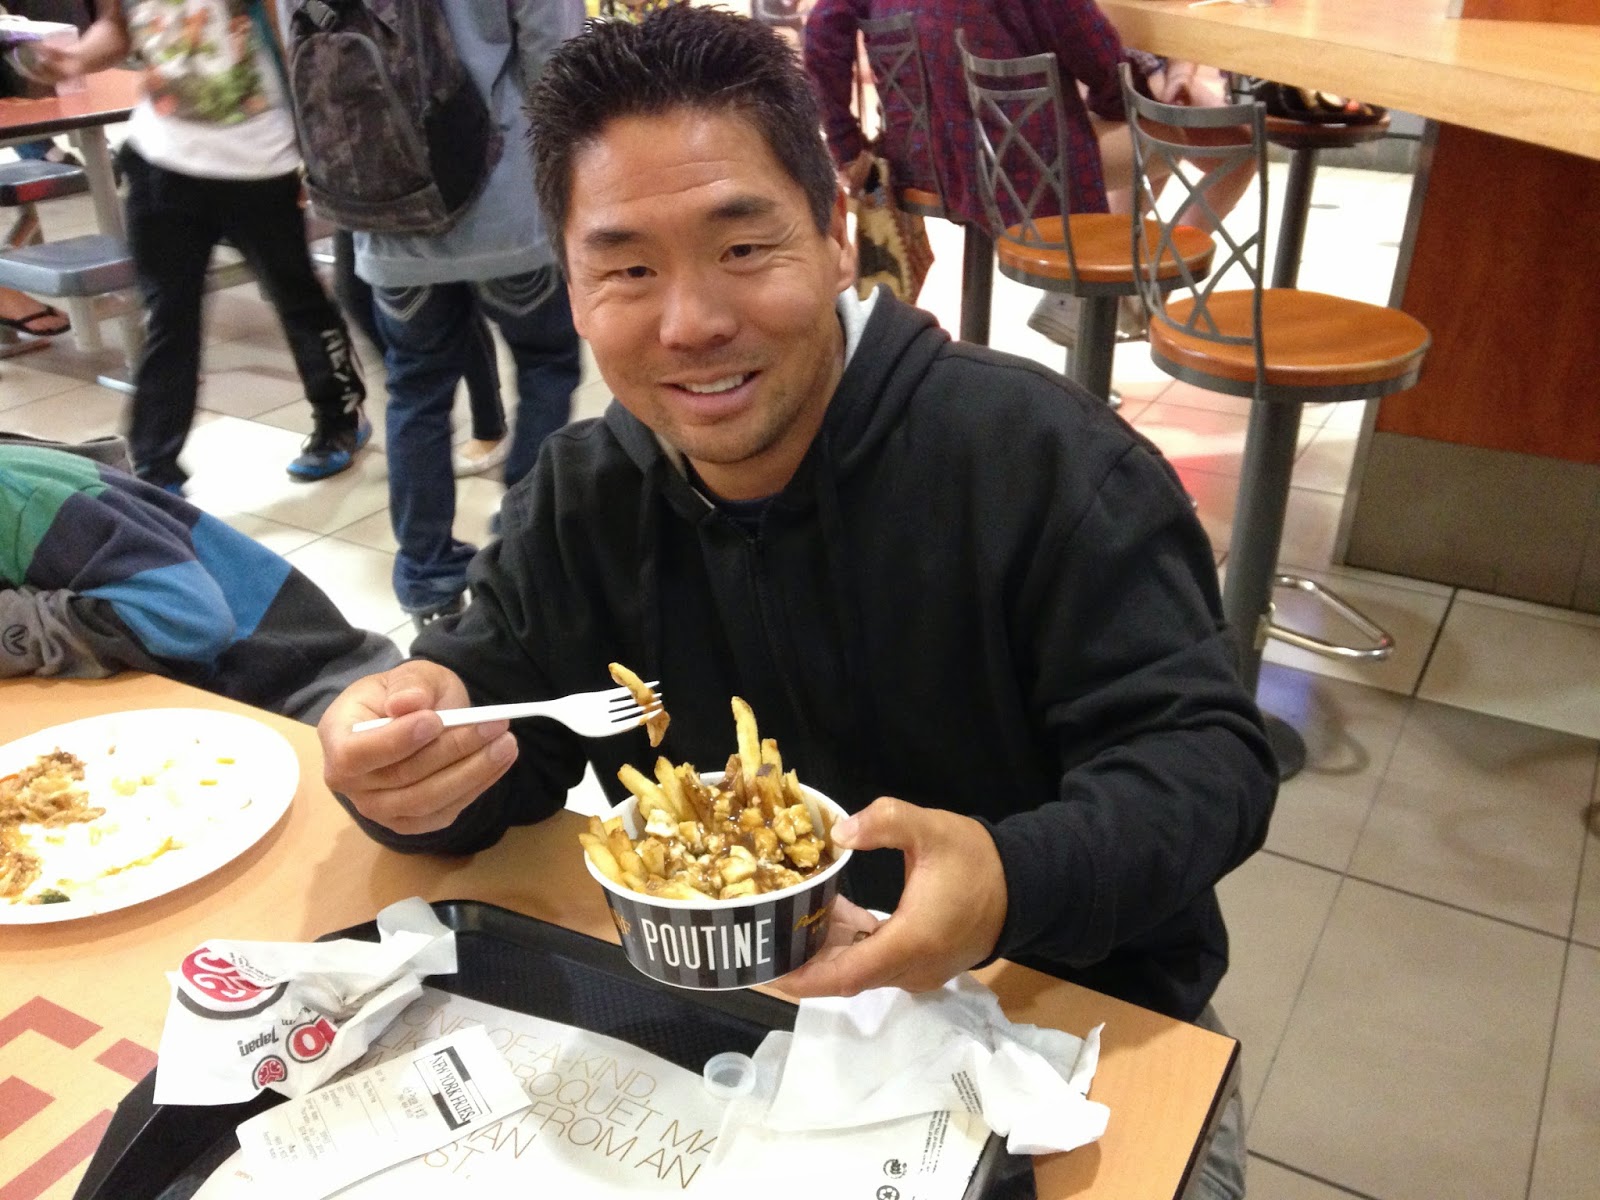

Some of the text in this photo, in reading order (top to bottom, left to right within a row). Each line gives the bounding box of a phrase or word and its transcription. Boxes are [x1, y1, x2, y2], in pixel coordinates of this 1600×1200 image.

[641, 918, 772, 970] POUTINE
[429, 1055, 451, 1075] NEW
[439, 1072, 463, 1098] YORK
[518, 1101, 702, 1189] FROM AN
